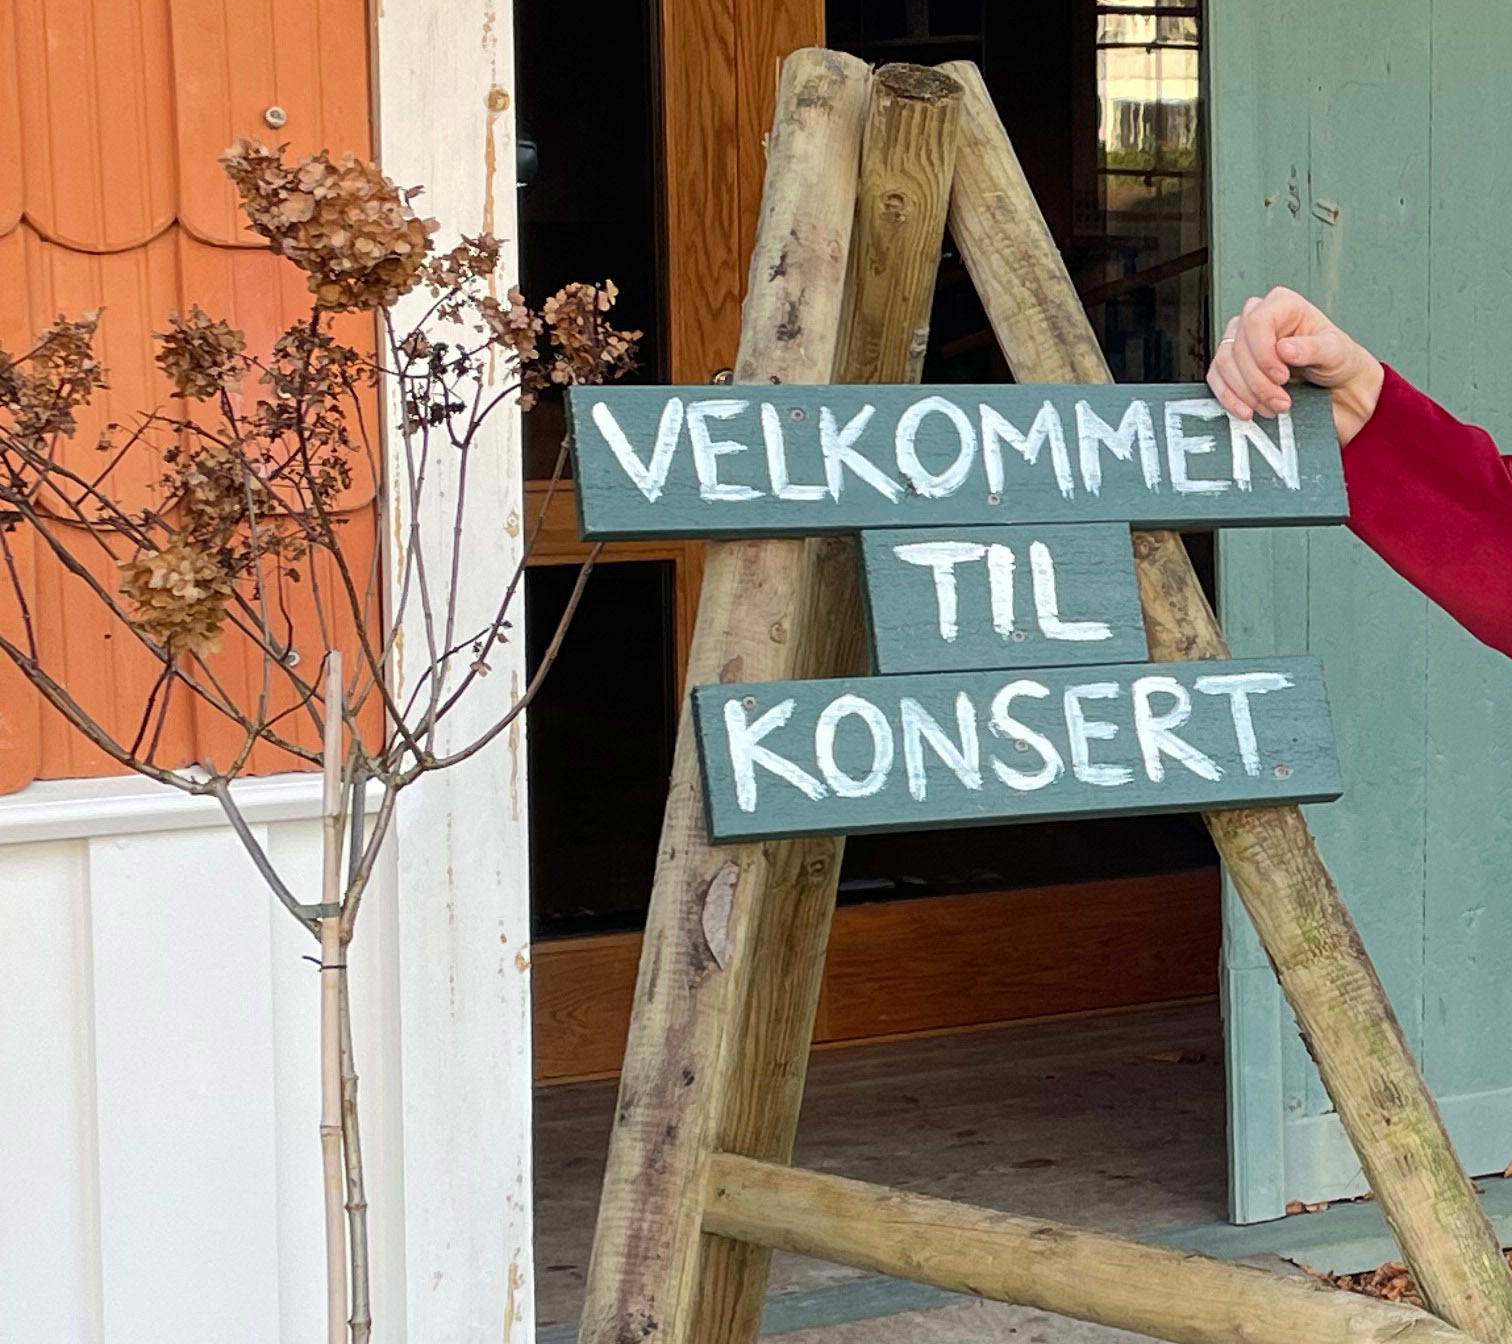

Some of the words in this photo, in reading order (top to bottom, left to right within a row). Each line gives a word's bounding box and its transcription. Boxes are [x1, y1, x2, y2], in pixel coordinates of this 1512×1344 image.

[591, 396, 1301, 502] VELKOMMEN
[892, 540, 1114, 643] TIL
[722, 672, 1294, 812] KONSERT
